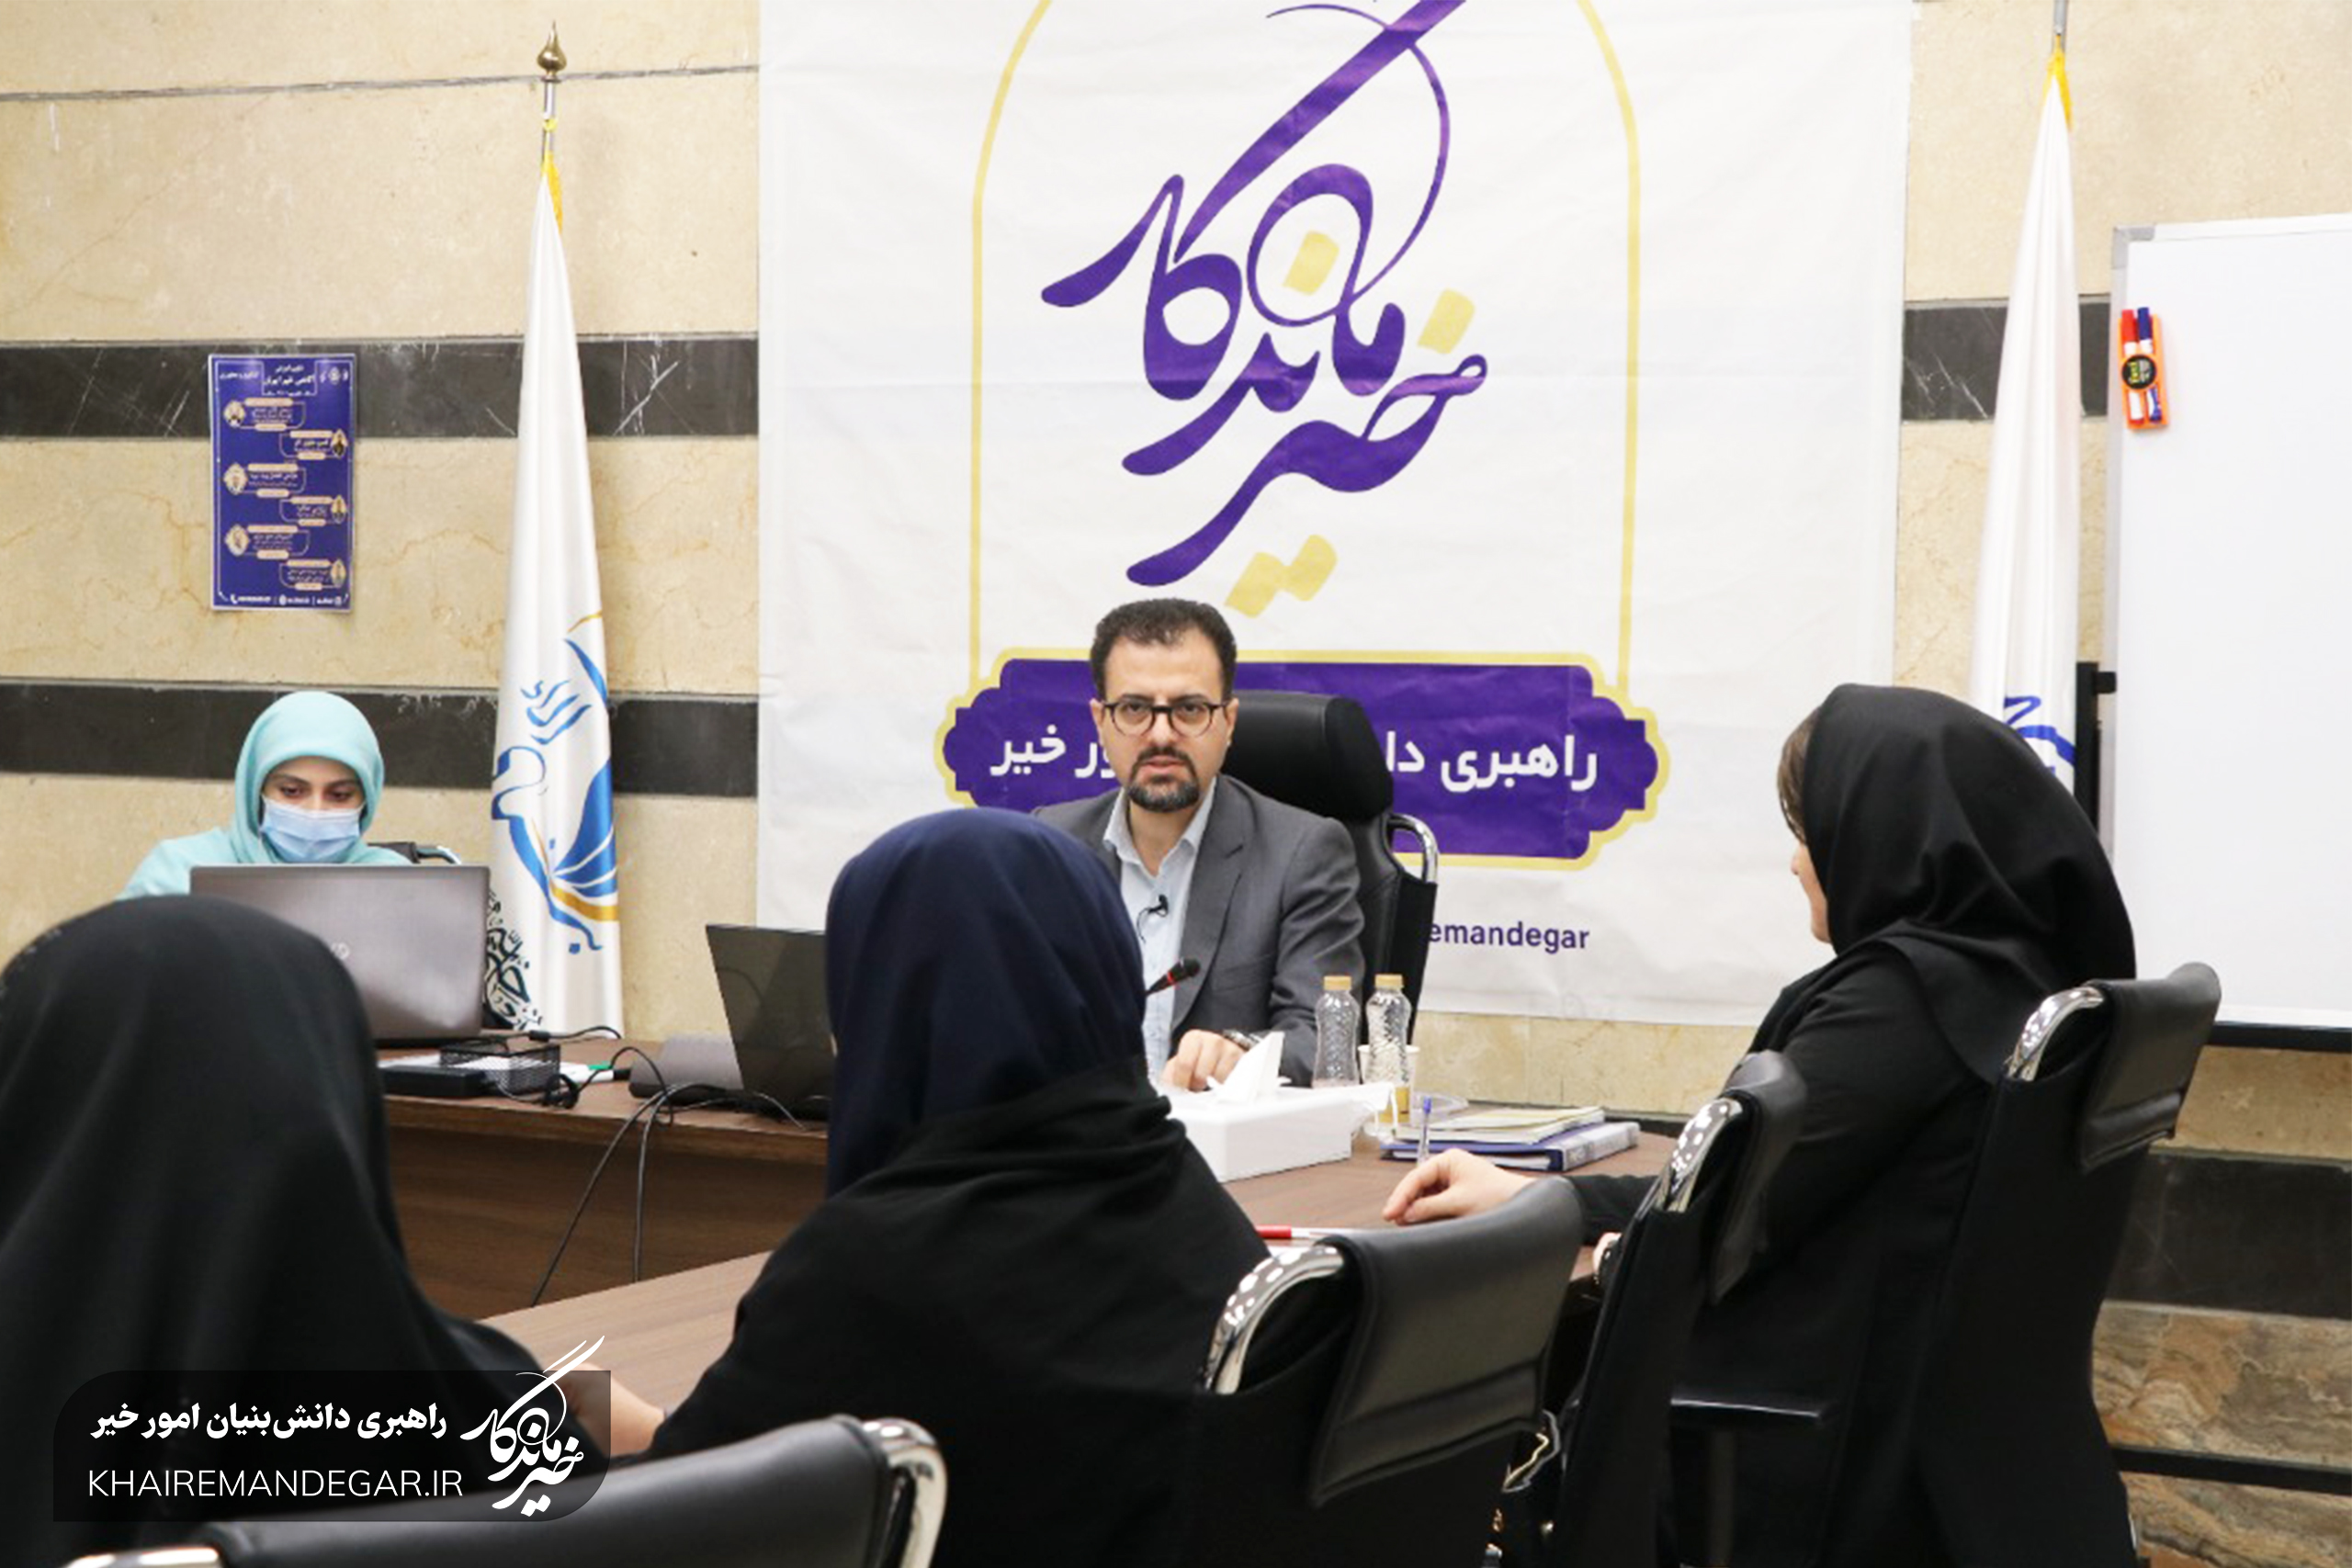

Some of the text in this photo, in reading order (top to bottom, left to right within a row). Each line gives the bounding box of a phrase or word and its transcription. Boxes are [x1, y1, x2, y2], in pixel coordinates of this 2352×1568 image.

[989, 725, 1066, 776] خیر
[1441, 735, 1597, 793] راهبری
[1430, 920, 1589, 954] emandegar
